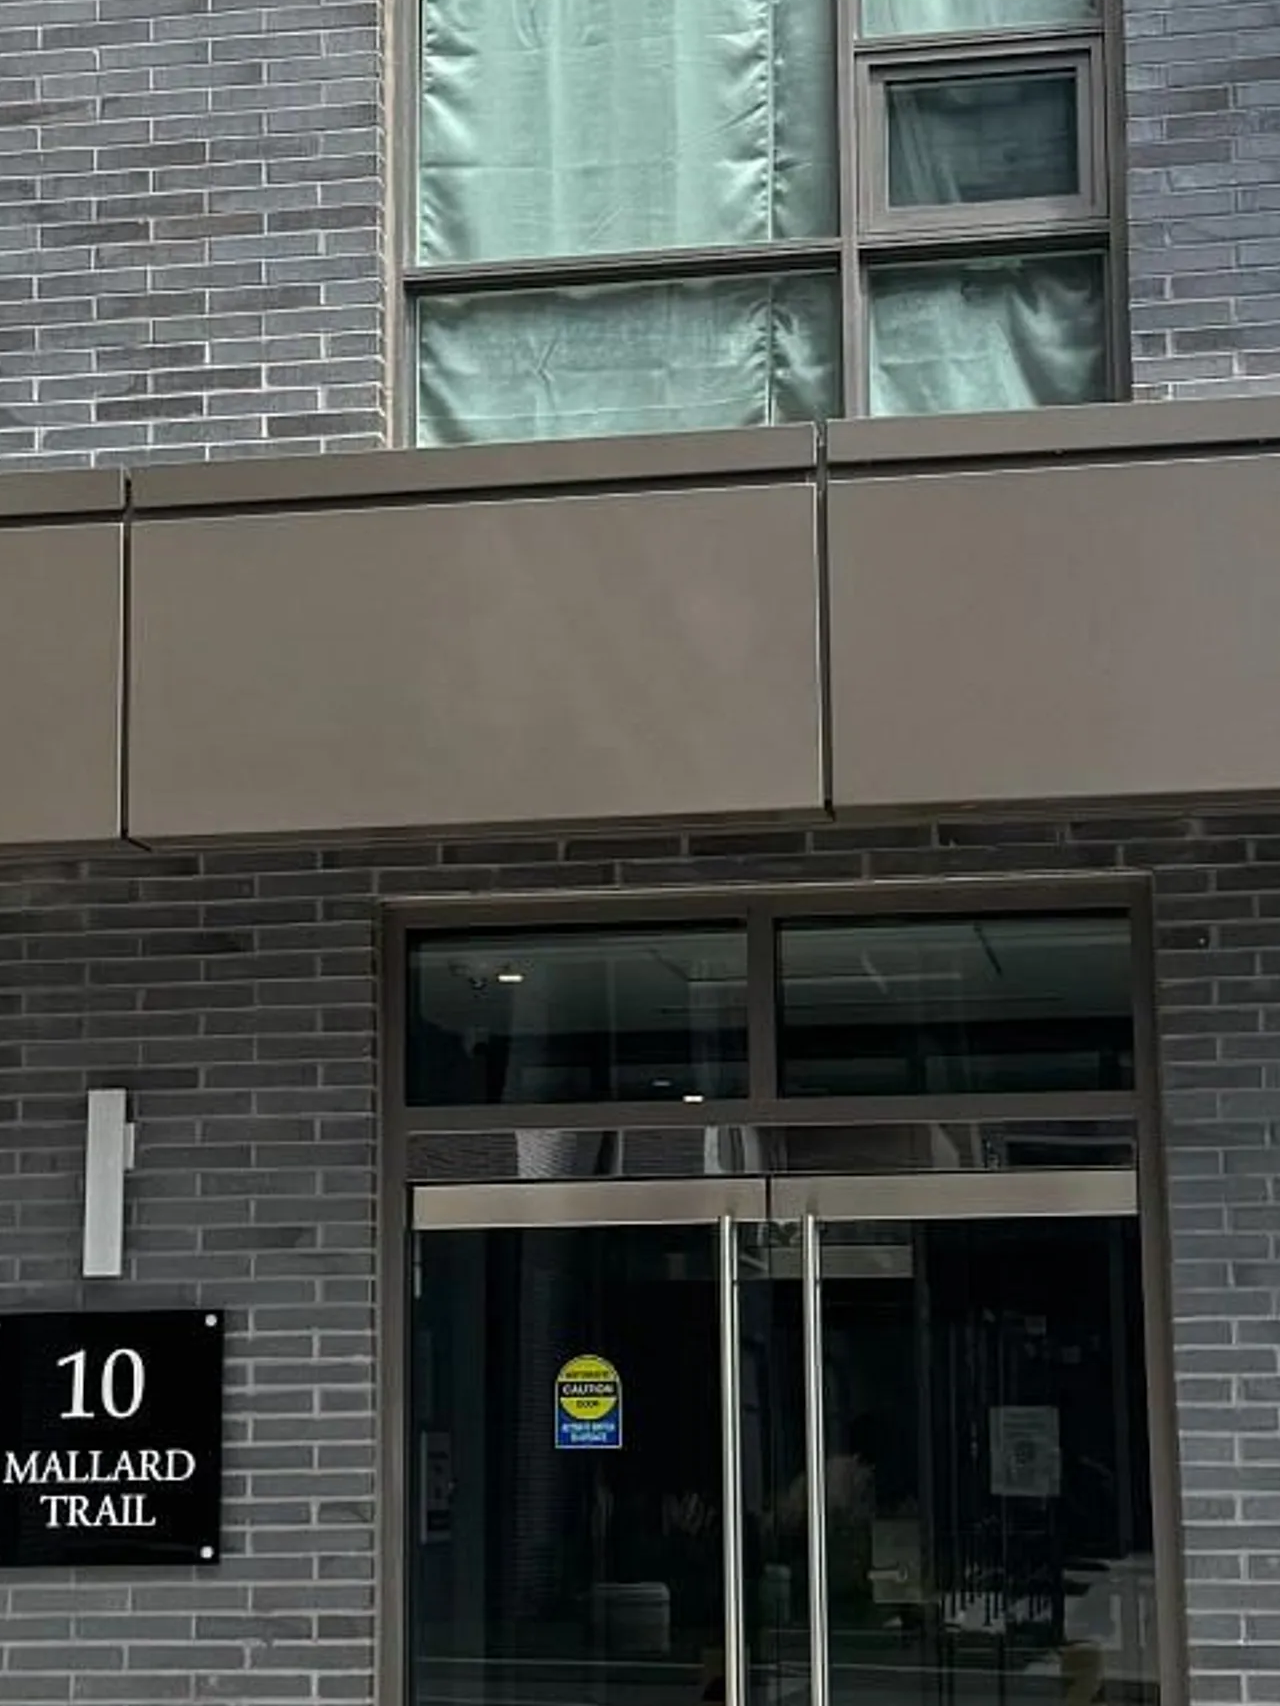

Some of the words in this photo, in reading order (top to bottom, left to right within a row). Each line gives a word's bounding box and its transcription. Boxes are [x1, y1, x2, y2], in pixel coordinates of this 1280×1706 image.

[56, 1347, 146, 1420] 10
[562, 1384, 614, 1395] CAUTION
[2, 1448, 196, 1485] MALLARD
[39, 1494, 157, 1528] TRAIL
